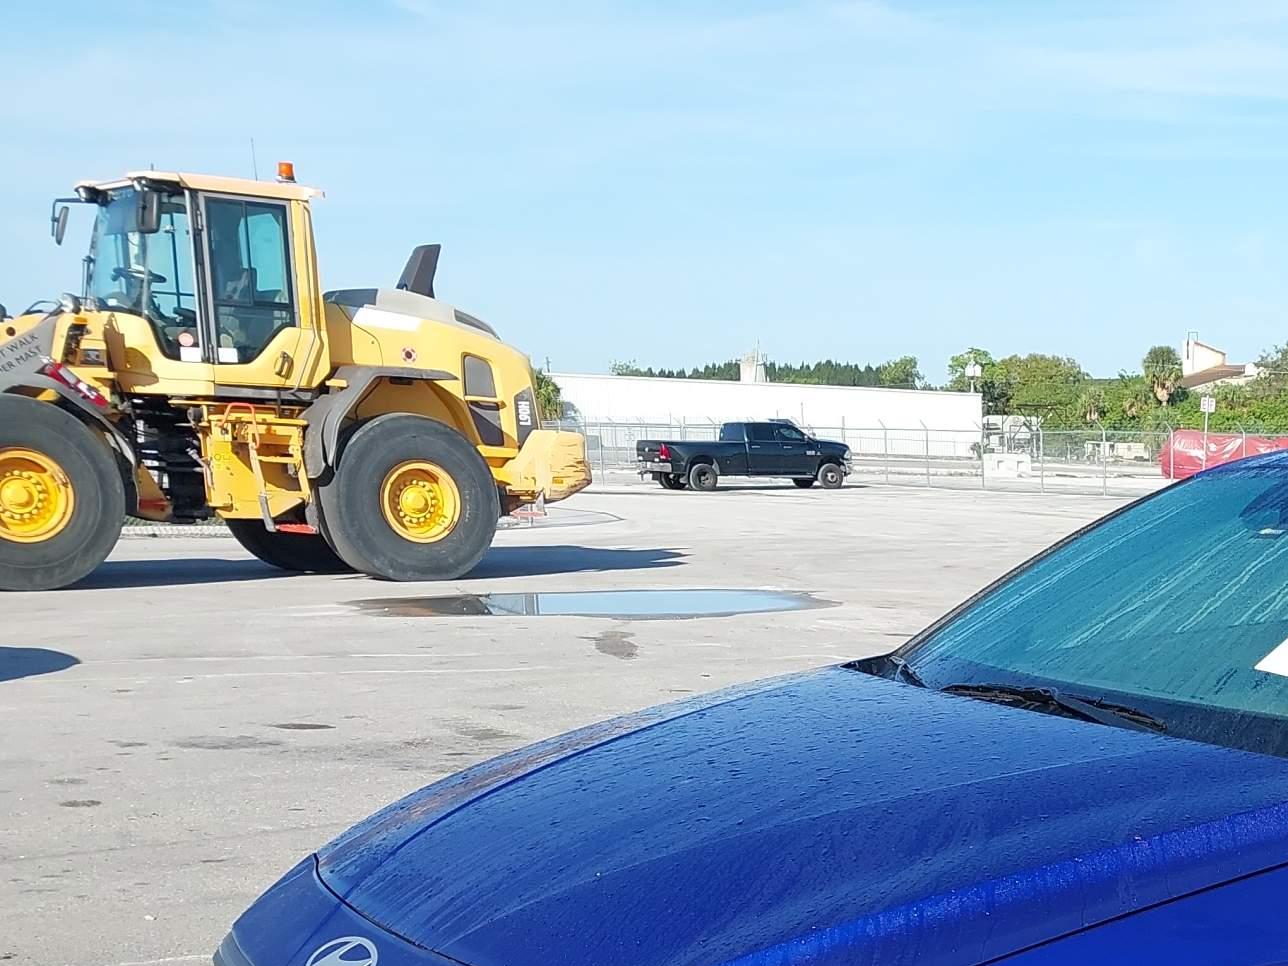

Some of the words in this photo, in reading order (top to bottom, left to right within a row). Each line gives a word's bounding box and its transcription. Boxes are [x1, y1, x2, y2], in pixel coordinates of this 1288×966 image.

[6, 333, 39, 352] WALK
[15, 345, 42, 365] MAST
[517, 401, 532, 426] L90H
